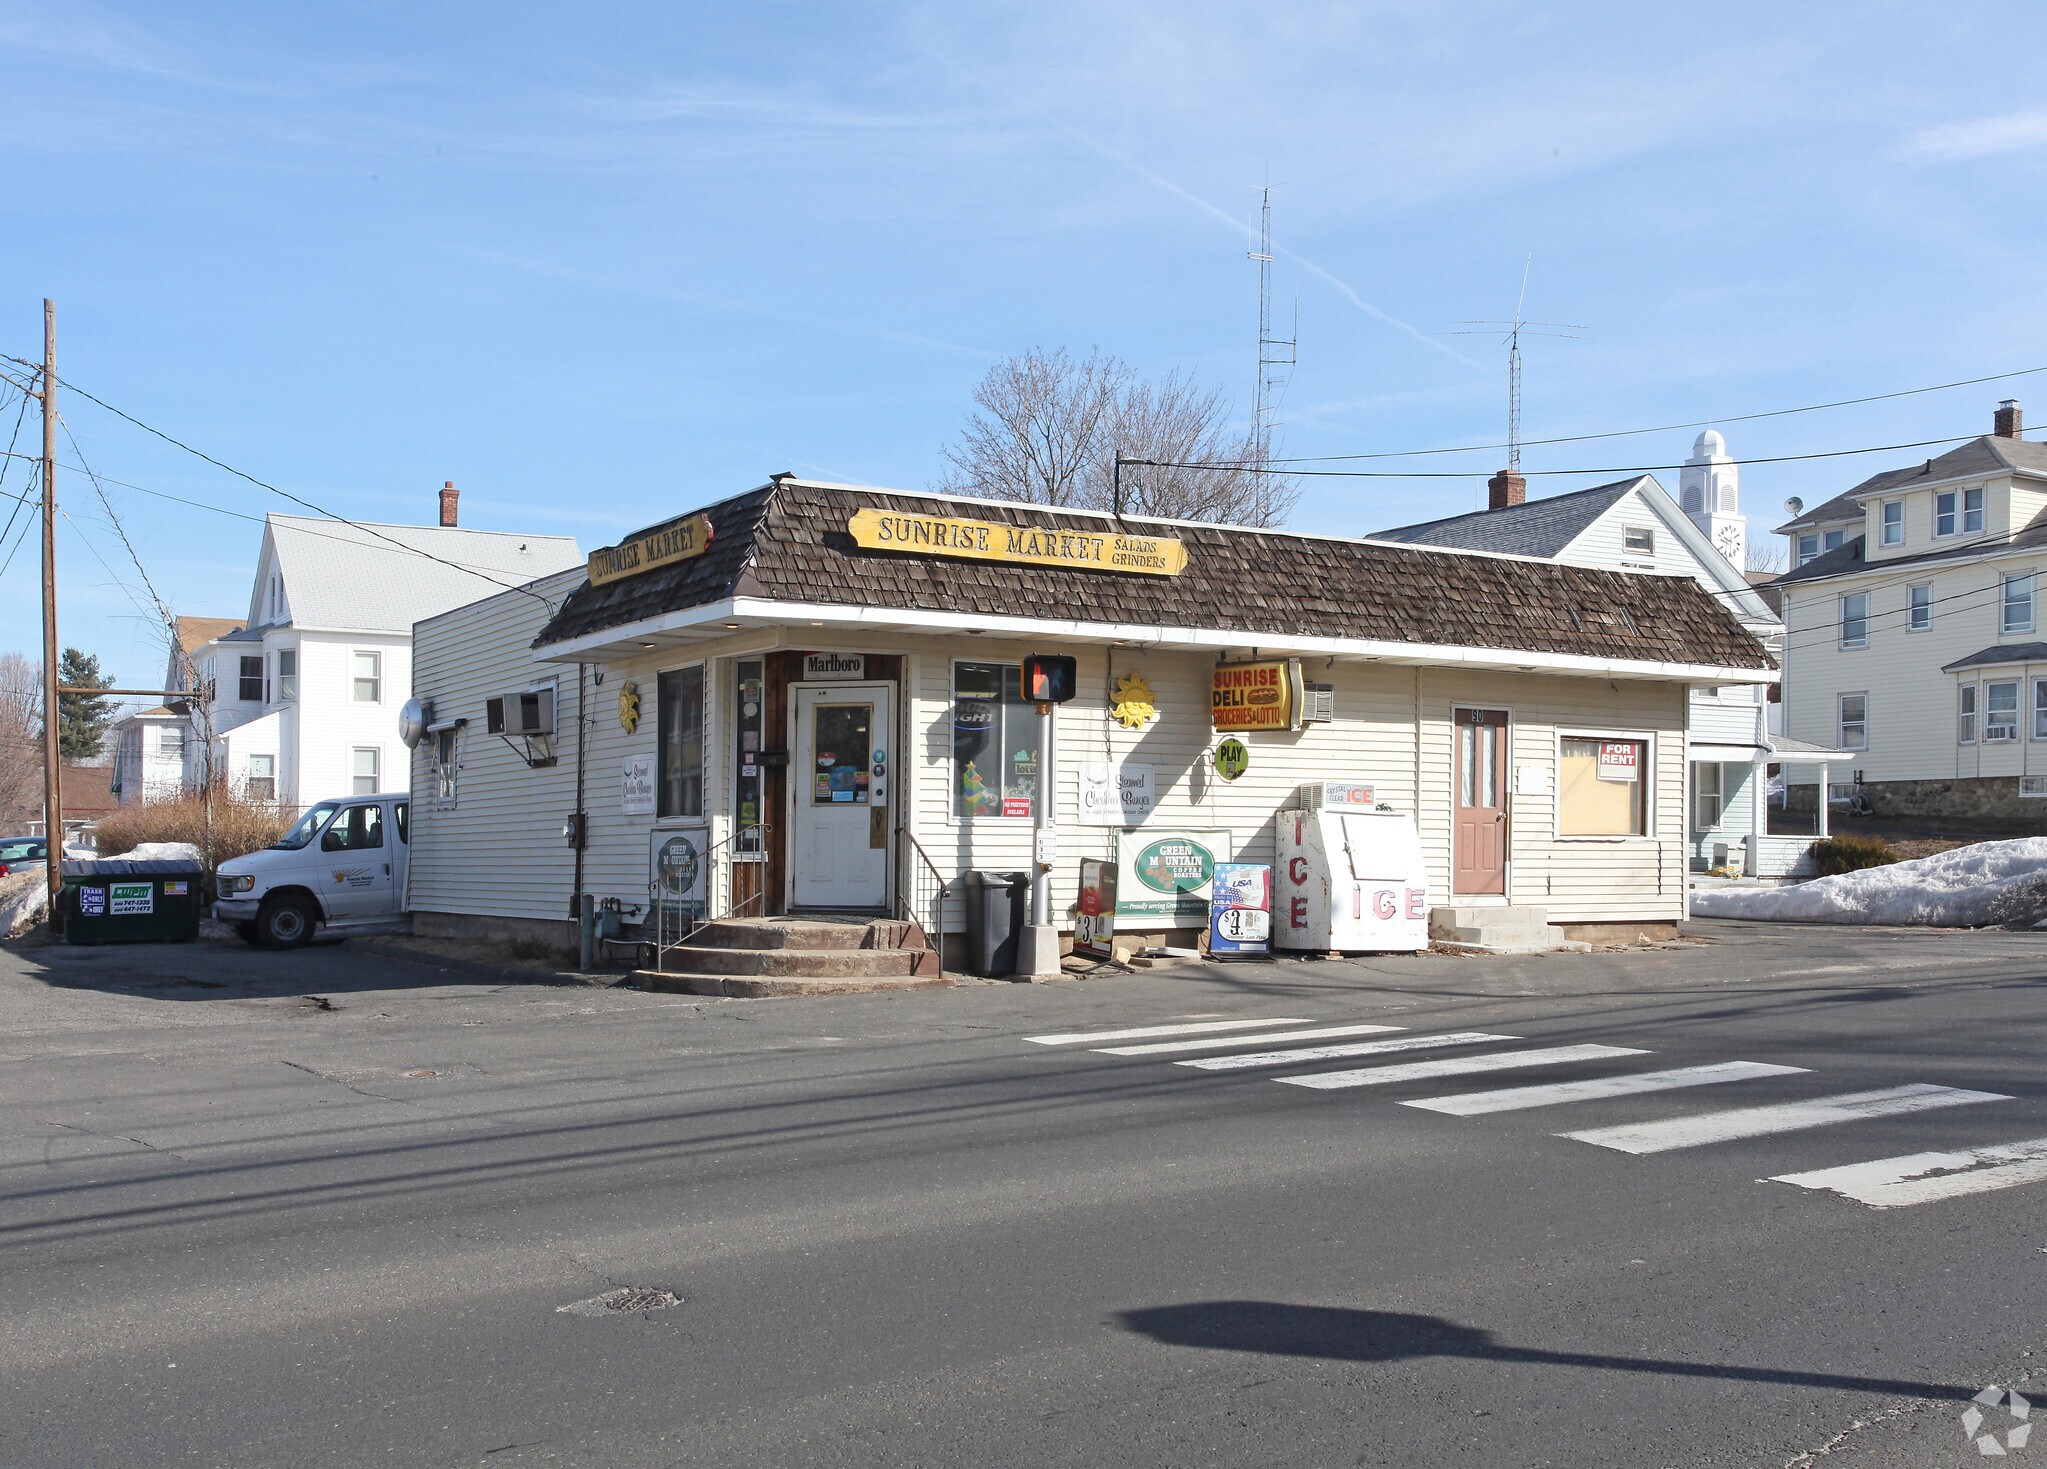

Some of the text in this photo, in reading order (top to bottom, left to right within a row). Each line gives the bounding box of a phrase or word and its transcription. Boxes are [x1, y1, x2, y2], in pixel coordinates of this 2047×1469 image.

[878, 517, 1104, 562] SUNRISE MARKET
[1113, 538, 1157, 554] SALADS
[596, 524, 694, 577] SUNRISE MARKET
[1111, 552, 1166, 570] GRINDERS
[807, 653, 860, 673] Marlboro
[1213, 668, 1278, 689] SUNRISE
[1213, 689, 1244, 707] DELI
[1472, 709, 1483, 722] 90
[1220, 745, 1243, 762] PLAY
[1606, 743, 1631, 755] FOR
[1601, 753, 1635, 765] RENT
[1326, 785, 1347, 796] CRYSTAL
[1346, 788, 1374, 804] ICE
[1328, 795, 1345, 803] CLEAR
[1160, 846, 1192, 856] GREEN
[1289, 817, 1308, 929] ICE
[1232, 879, 1252, 888] USA
[1129, 902, 1148, 911] Proudly
[1148, 903, 1165, 911] serving
[1352, 884, 1426, 920] ICE
